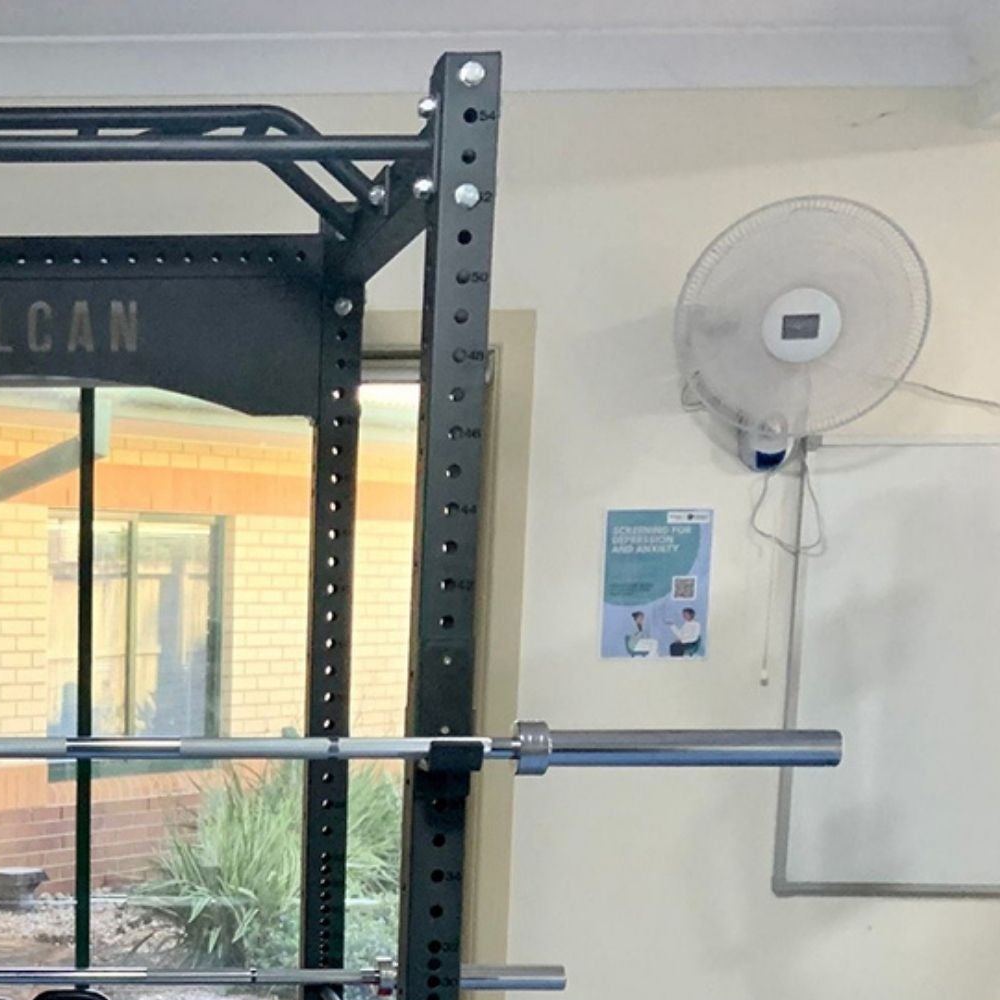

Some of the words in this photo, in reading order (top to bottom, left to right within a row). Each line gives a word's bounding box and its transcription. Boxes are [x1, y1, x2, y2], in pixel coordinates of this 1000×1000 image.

[479, 110, 496, 121] 54
[471, 272, 489, 283] 50
[611, 534, 674, 545] DEPRESSION
[611, 545, 634, 553] AND
[636, 544, 680, 553] ANXIETY
